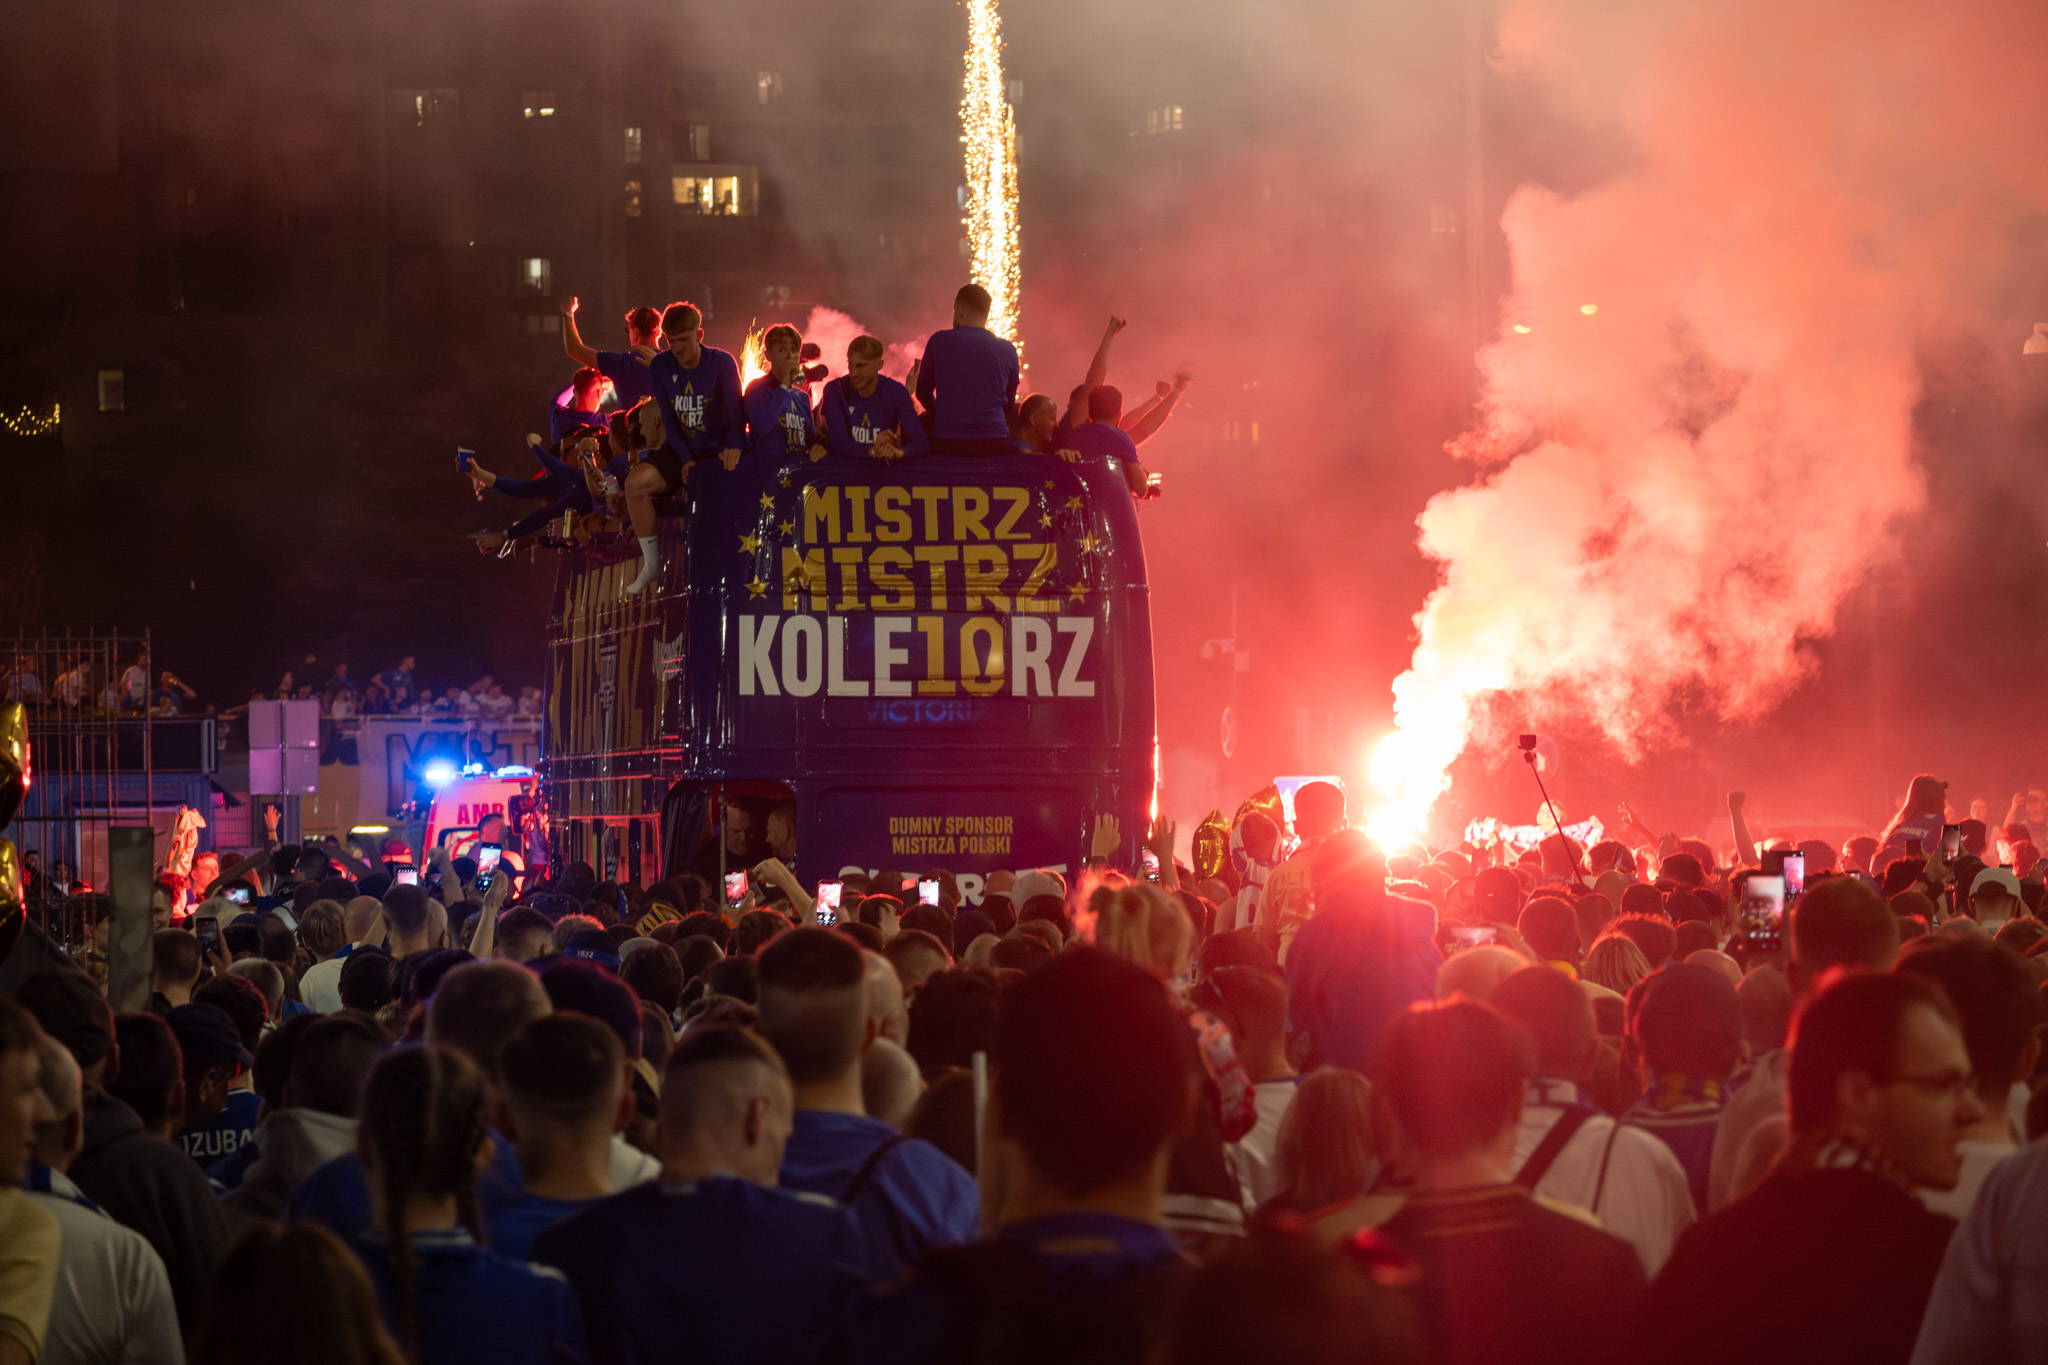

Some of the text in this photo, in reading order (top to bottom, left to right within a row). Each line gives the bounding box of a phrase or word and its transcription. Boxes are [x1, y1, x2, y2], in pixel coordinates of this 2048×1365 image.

[674, 394, 704, 412] KOLE
[785, 412, 806, 433] KOLE
[802, 484, 1032, 544] MISTRZ
[781, 542, 1061, 613] MISTRZ
[738, 613, 1095, 698] KOLE10RZ
[889, 816, 1014, 835] DUMNY SPONSOR
[892, 835, 1011, 855] MISTRZA POLSKI
